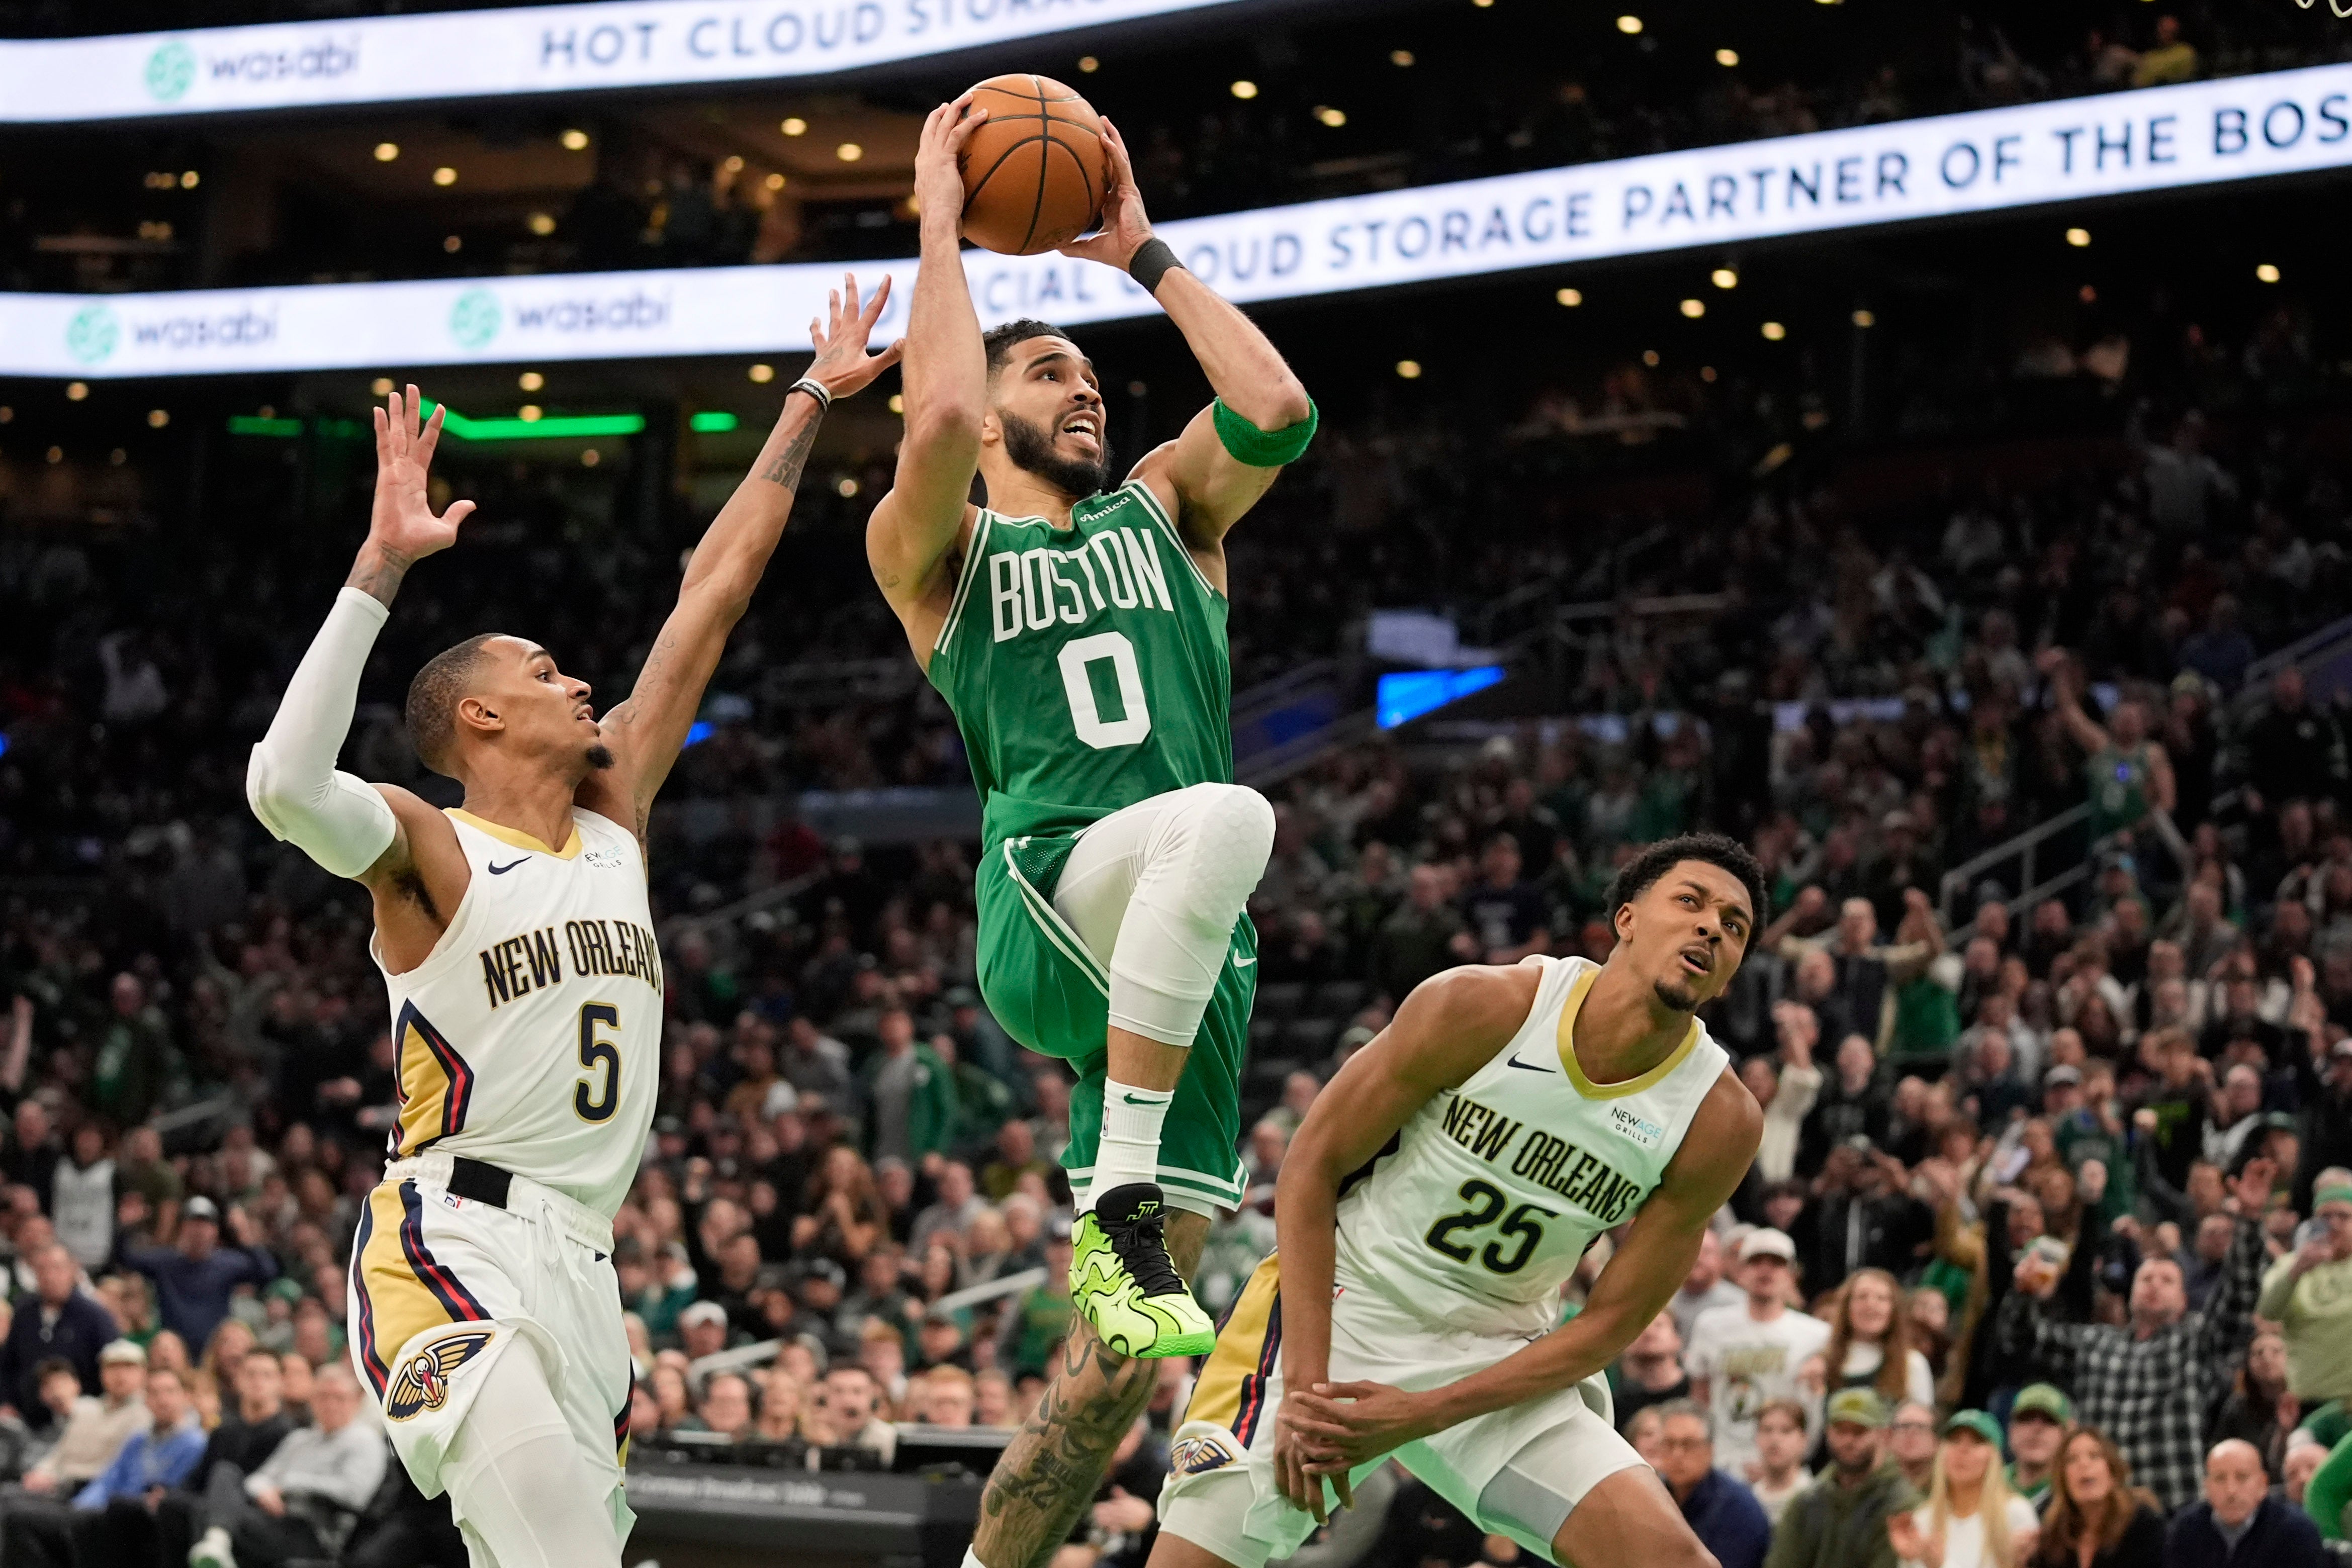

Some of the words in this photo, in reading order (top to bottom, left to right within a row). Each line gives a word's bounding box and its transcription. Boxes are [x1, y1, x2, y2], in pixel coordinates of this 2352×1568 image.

[208, 33, 360, 81] wasabi
[540, 23, 658, 66] HOT
[687, 2, 886, 58] CLOUD
[1328, 190, 1592, 268] STORAGE
[1621, 151, 1909, 229] PARTNER
[1940, 135, 2022, 189] OF
[2053, 116, 2177, 173] THE
[2215, 94, 2349, 154] BOS
[134, 305, 278, 349] wasabi
[516, 289, 669, 331] wasabi
[1079, 496, 1131, 522] Amica
[989, 527, 1174, 642] BOSTON
[1057, 631, 1151, 749] 0
[480, 927, 562, 1011] NEW
[572, 1001, 621, 1124] 5
[1441, 1094, 1524, 1164] NEW
[1510, 1131, 1641, 1223] ORLEANS
[1615, 1124, 1648, 1143] GRILLS
[1424, 1177, 1560, 1276] 25
